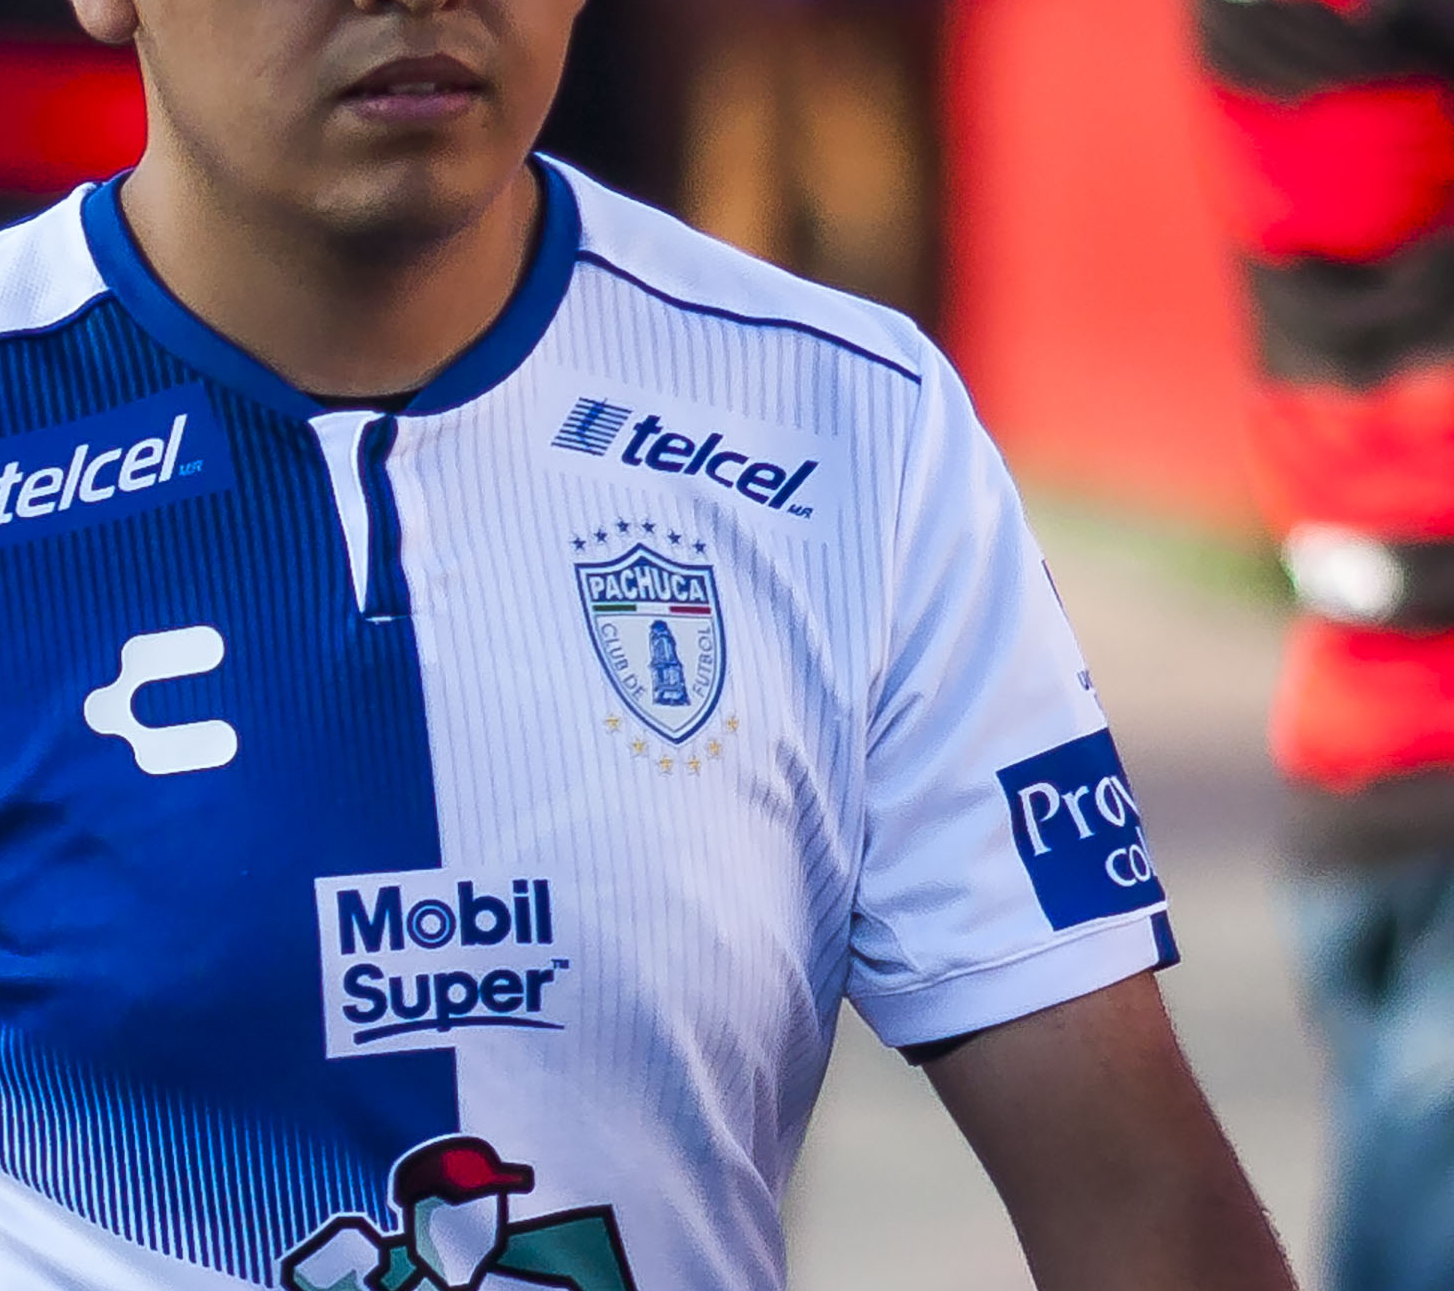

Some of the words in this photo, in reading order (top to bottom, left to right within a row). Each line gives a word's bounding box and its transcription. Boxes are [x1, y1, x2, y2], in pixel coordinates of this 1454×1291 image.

[621, 415, 819, 509] telcel
[592, 567, 705, 601] PACHUCA
[601, 623, 627, 671] CLUB
[623, 677, 646, 700] DE
[692, 627, 712, 698] FUTBOL
[336, 879, 553, 955] Mobil
[342, 963, 554, 1032] Super
